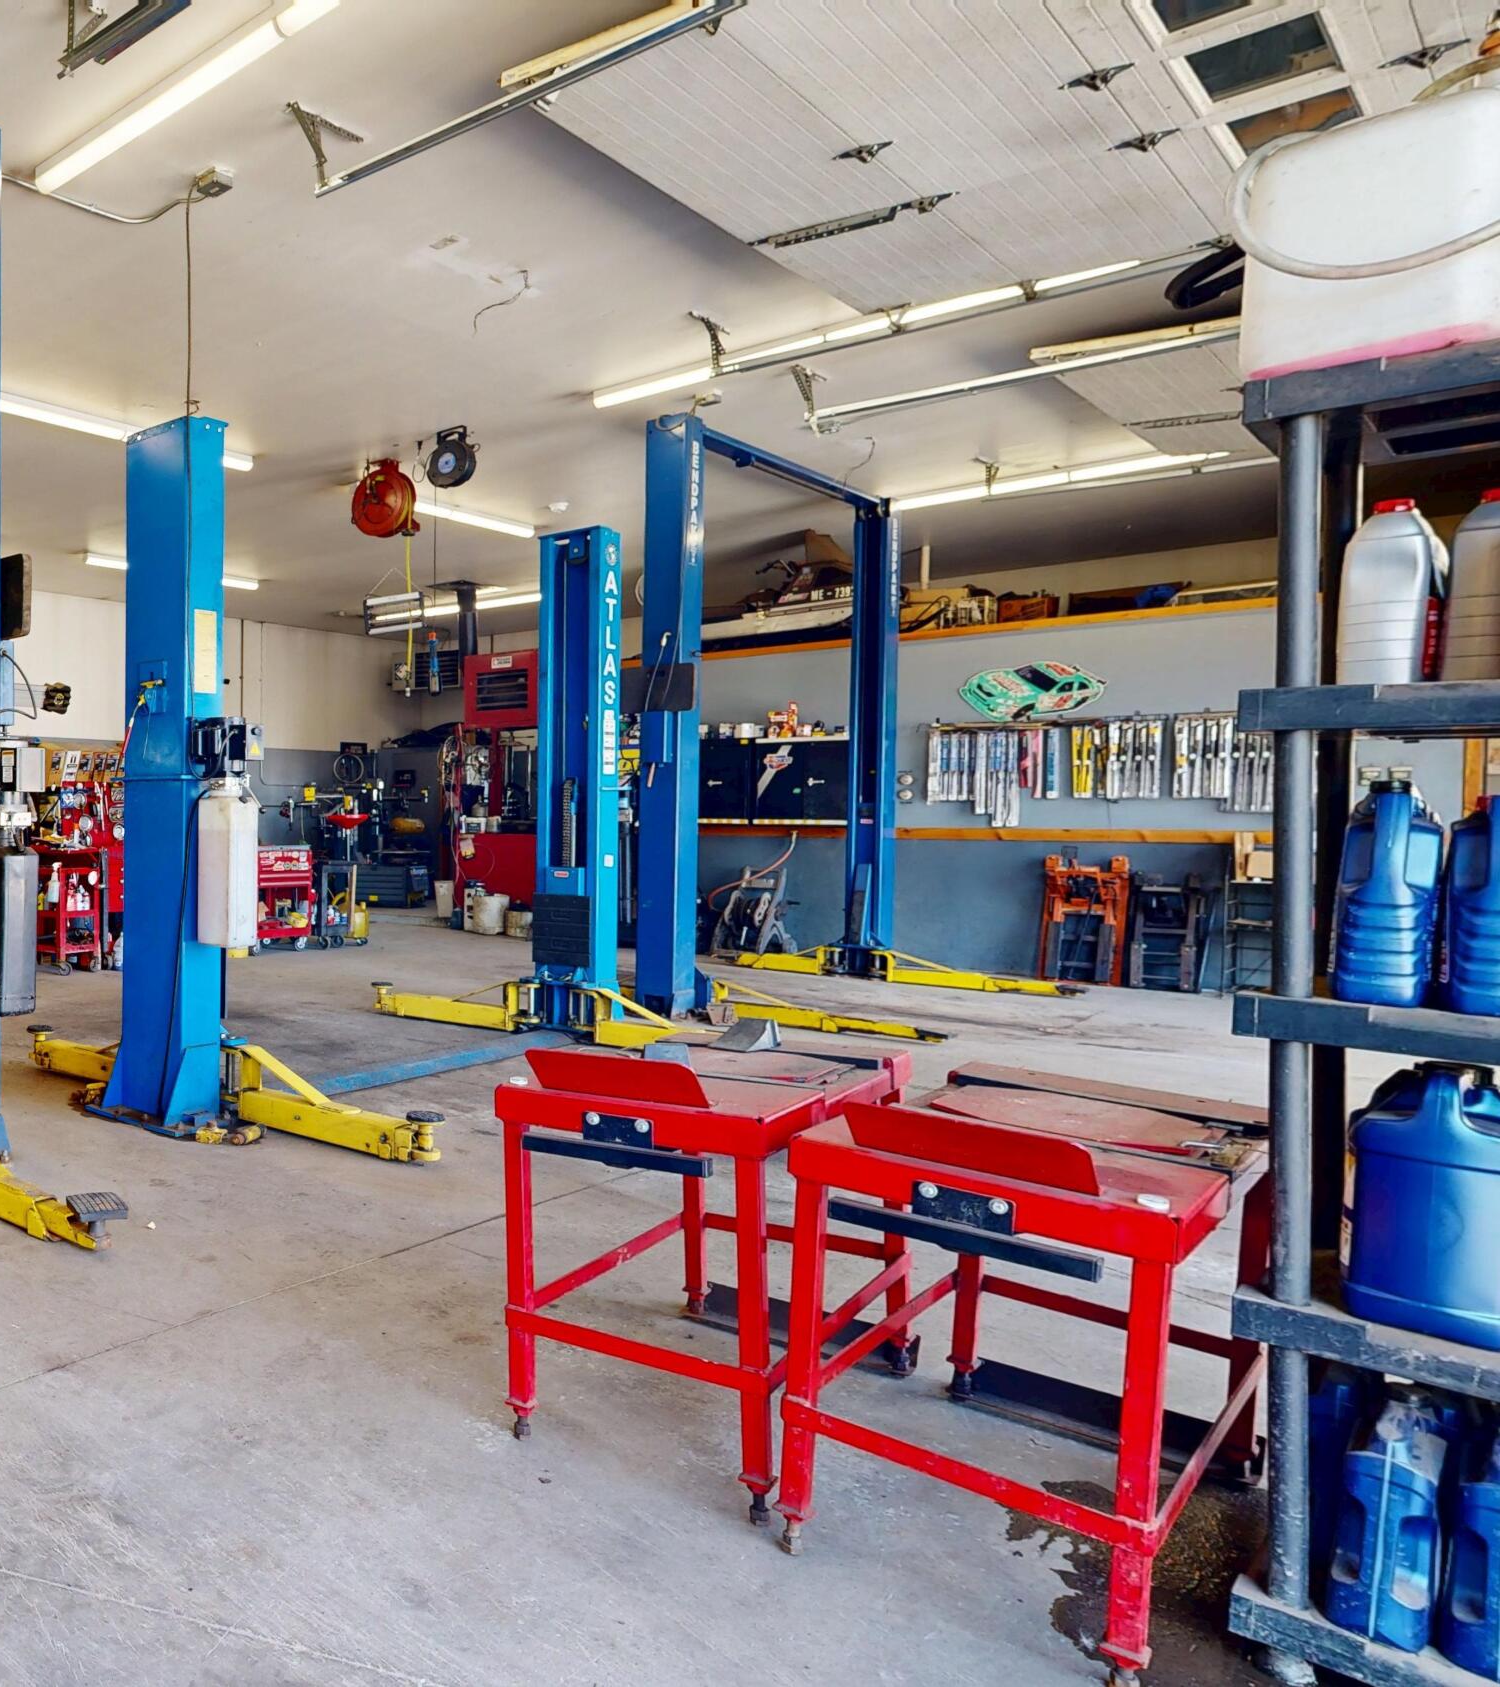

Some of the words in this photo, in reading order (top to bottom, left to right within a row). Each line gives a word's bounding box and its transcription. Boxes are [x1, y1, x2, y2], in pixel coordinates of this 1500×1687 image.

[810, 589, 825, 601] ME
[834, 585, 854, 599] 739
[603, 570, 618, 705] ATLAS
